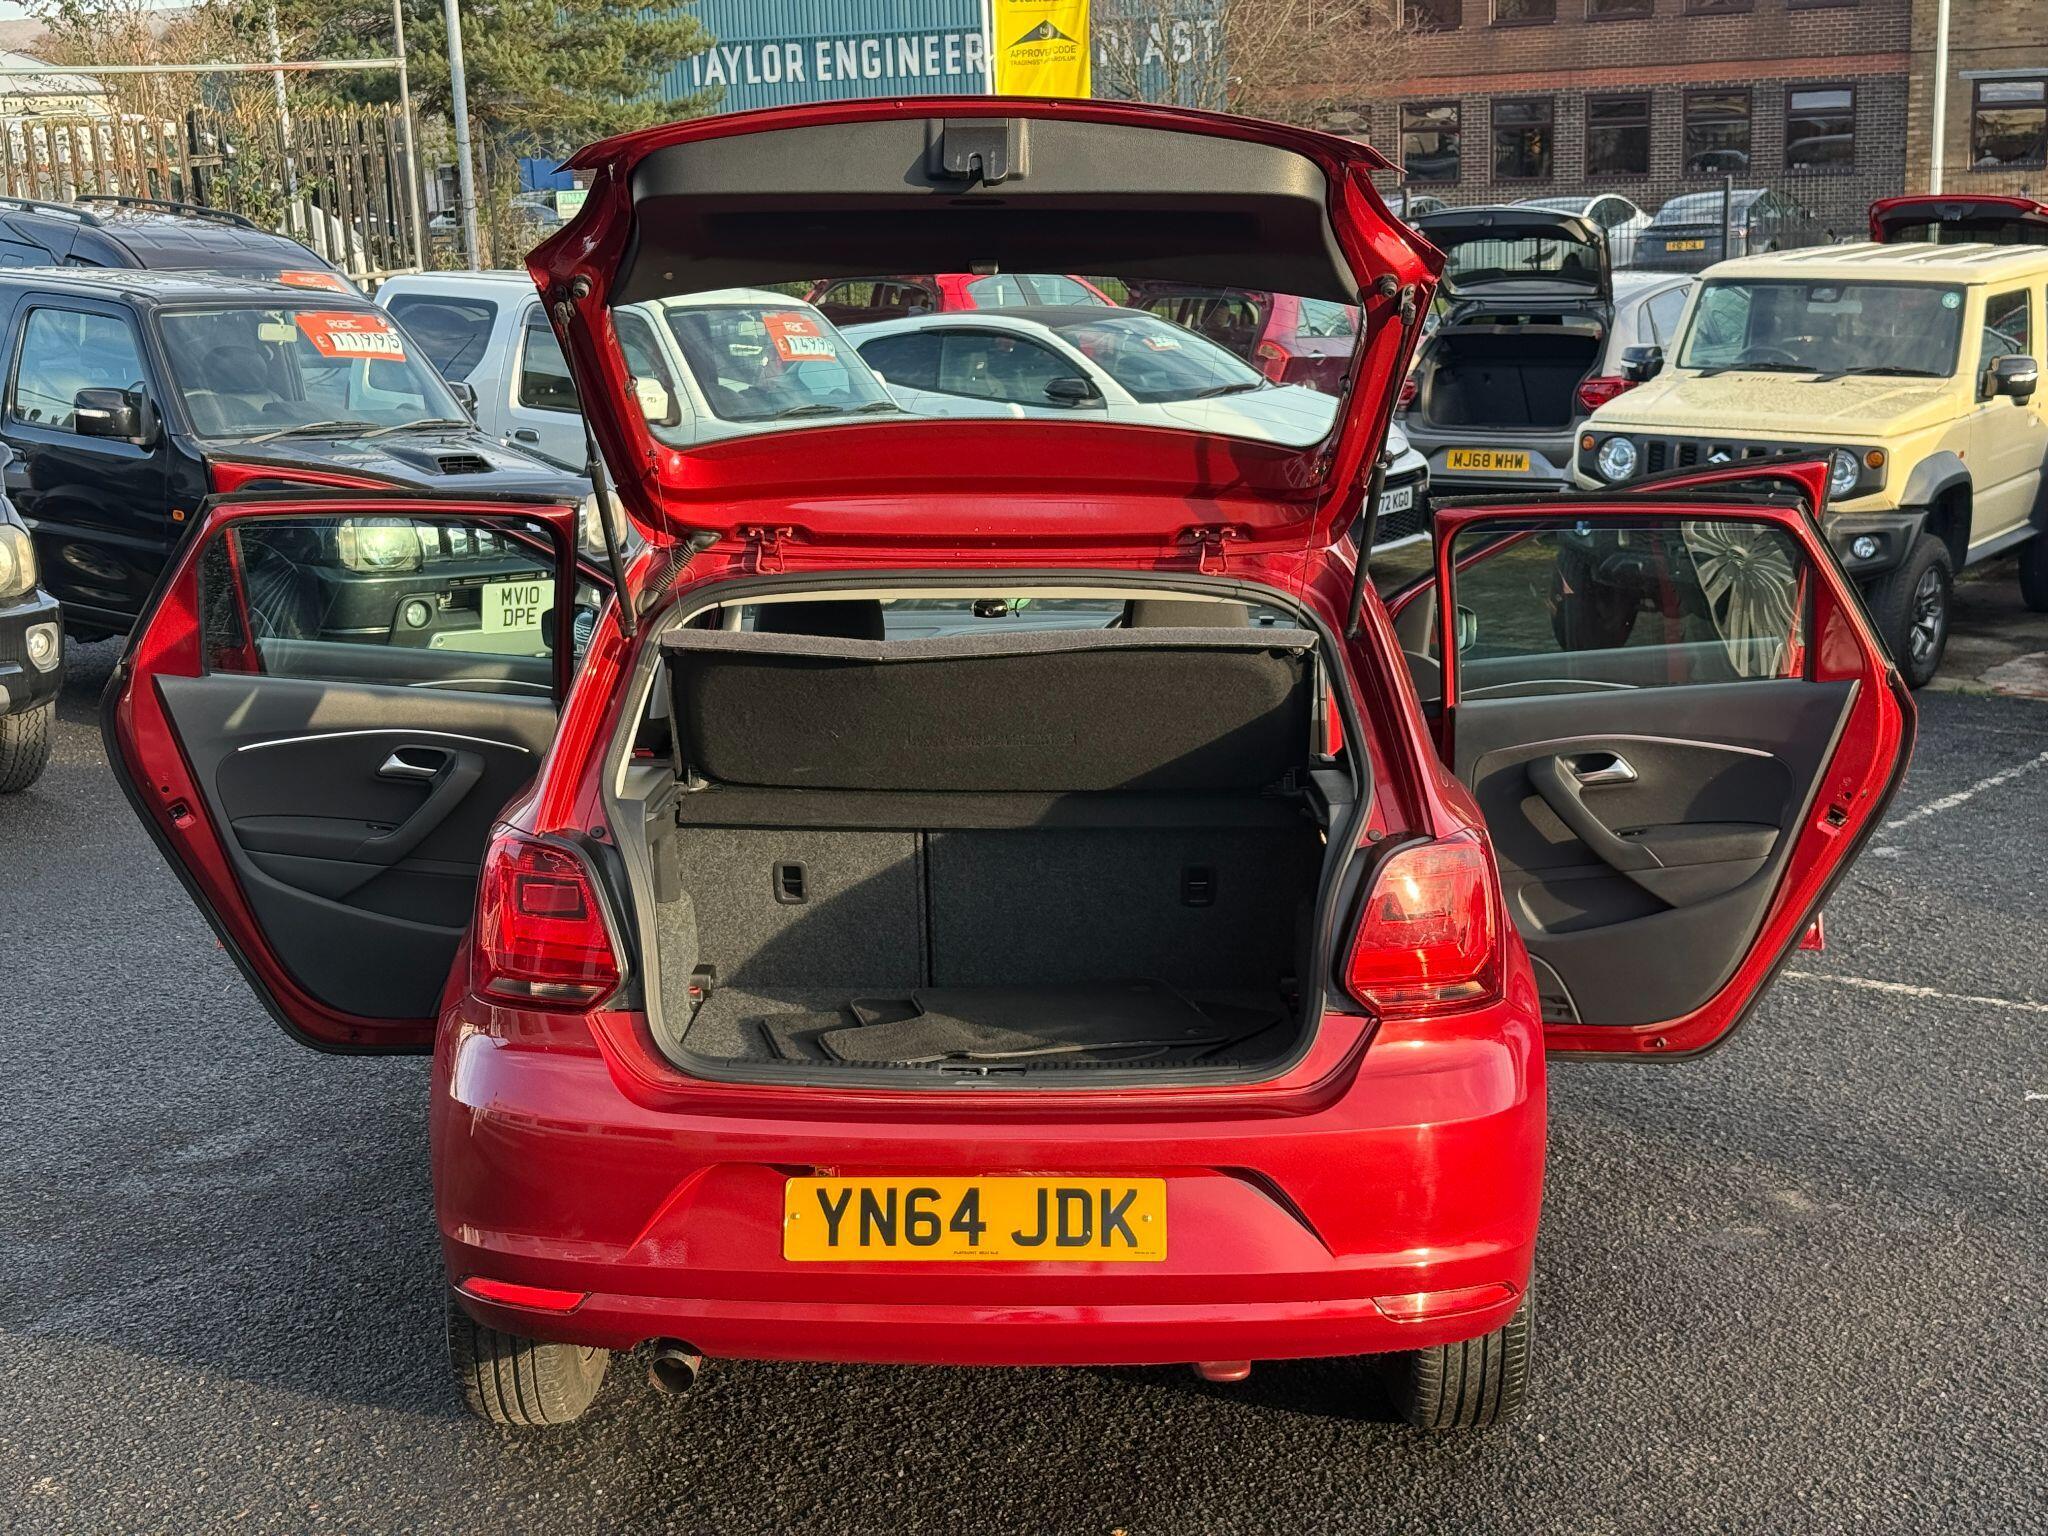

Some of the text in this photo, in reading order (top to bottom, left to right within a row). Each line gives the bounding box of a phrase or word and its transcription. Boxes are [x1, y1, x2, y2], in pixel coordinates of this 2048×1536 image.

[692, 42, 806, 87] TAYLOR
[815, 32, 986, 82] ENGINEER
[1453, 452, 1524, 469] MJ68 WHW
[501, 586, 540, 606] MV10
[502, 607, 537, 627] DPE
[816, 1187, 1138, 1247] YN64 JDK
